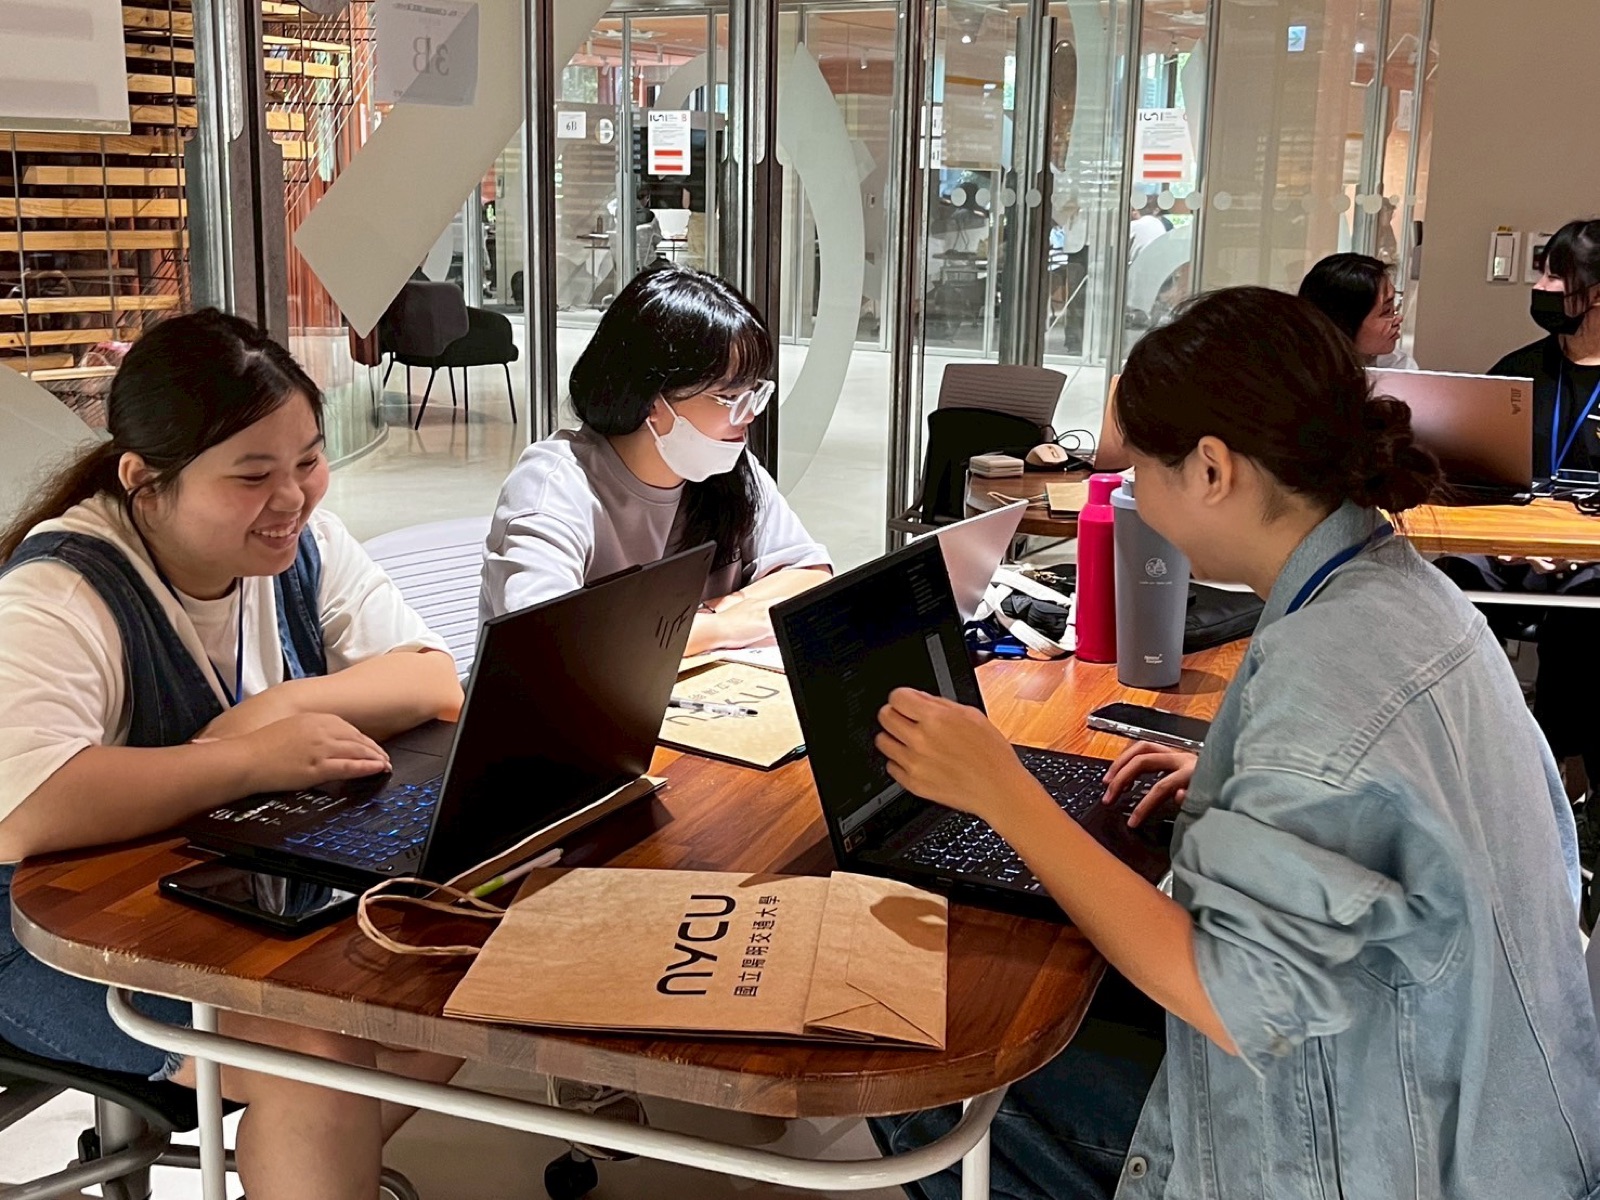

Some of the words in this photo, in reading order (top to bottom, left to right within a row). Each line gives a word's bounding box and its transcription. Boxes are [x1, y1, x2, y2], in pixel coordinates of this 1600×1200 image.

[656, 894, 736, 995] NYCU
[733, 895, 780, 997] 國立陽明交通大學
